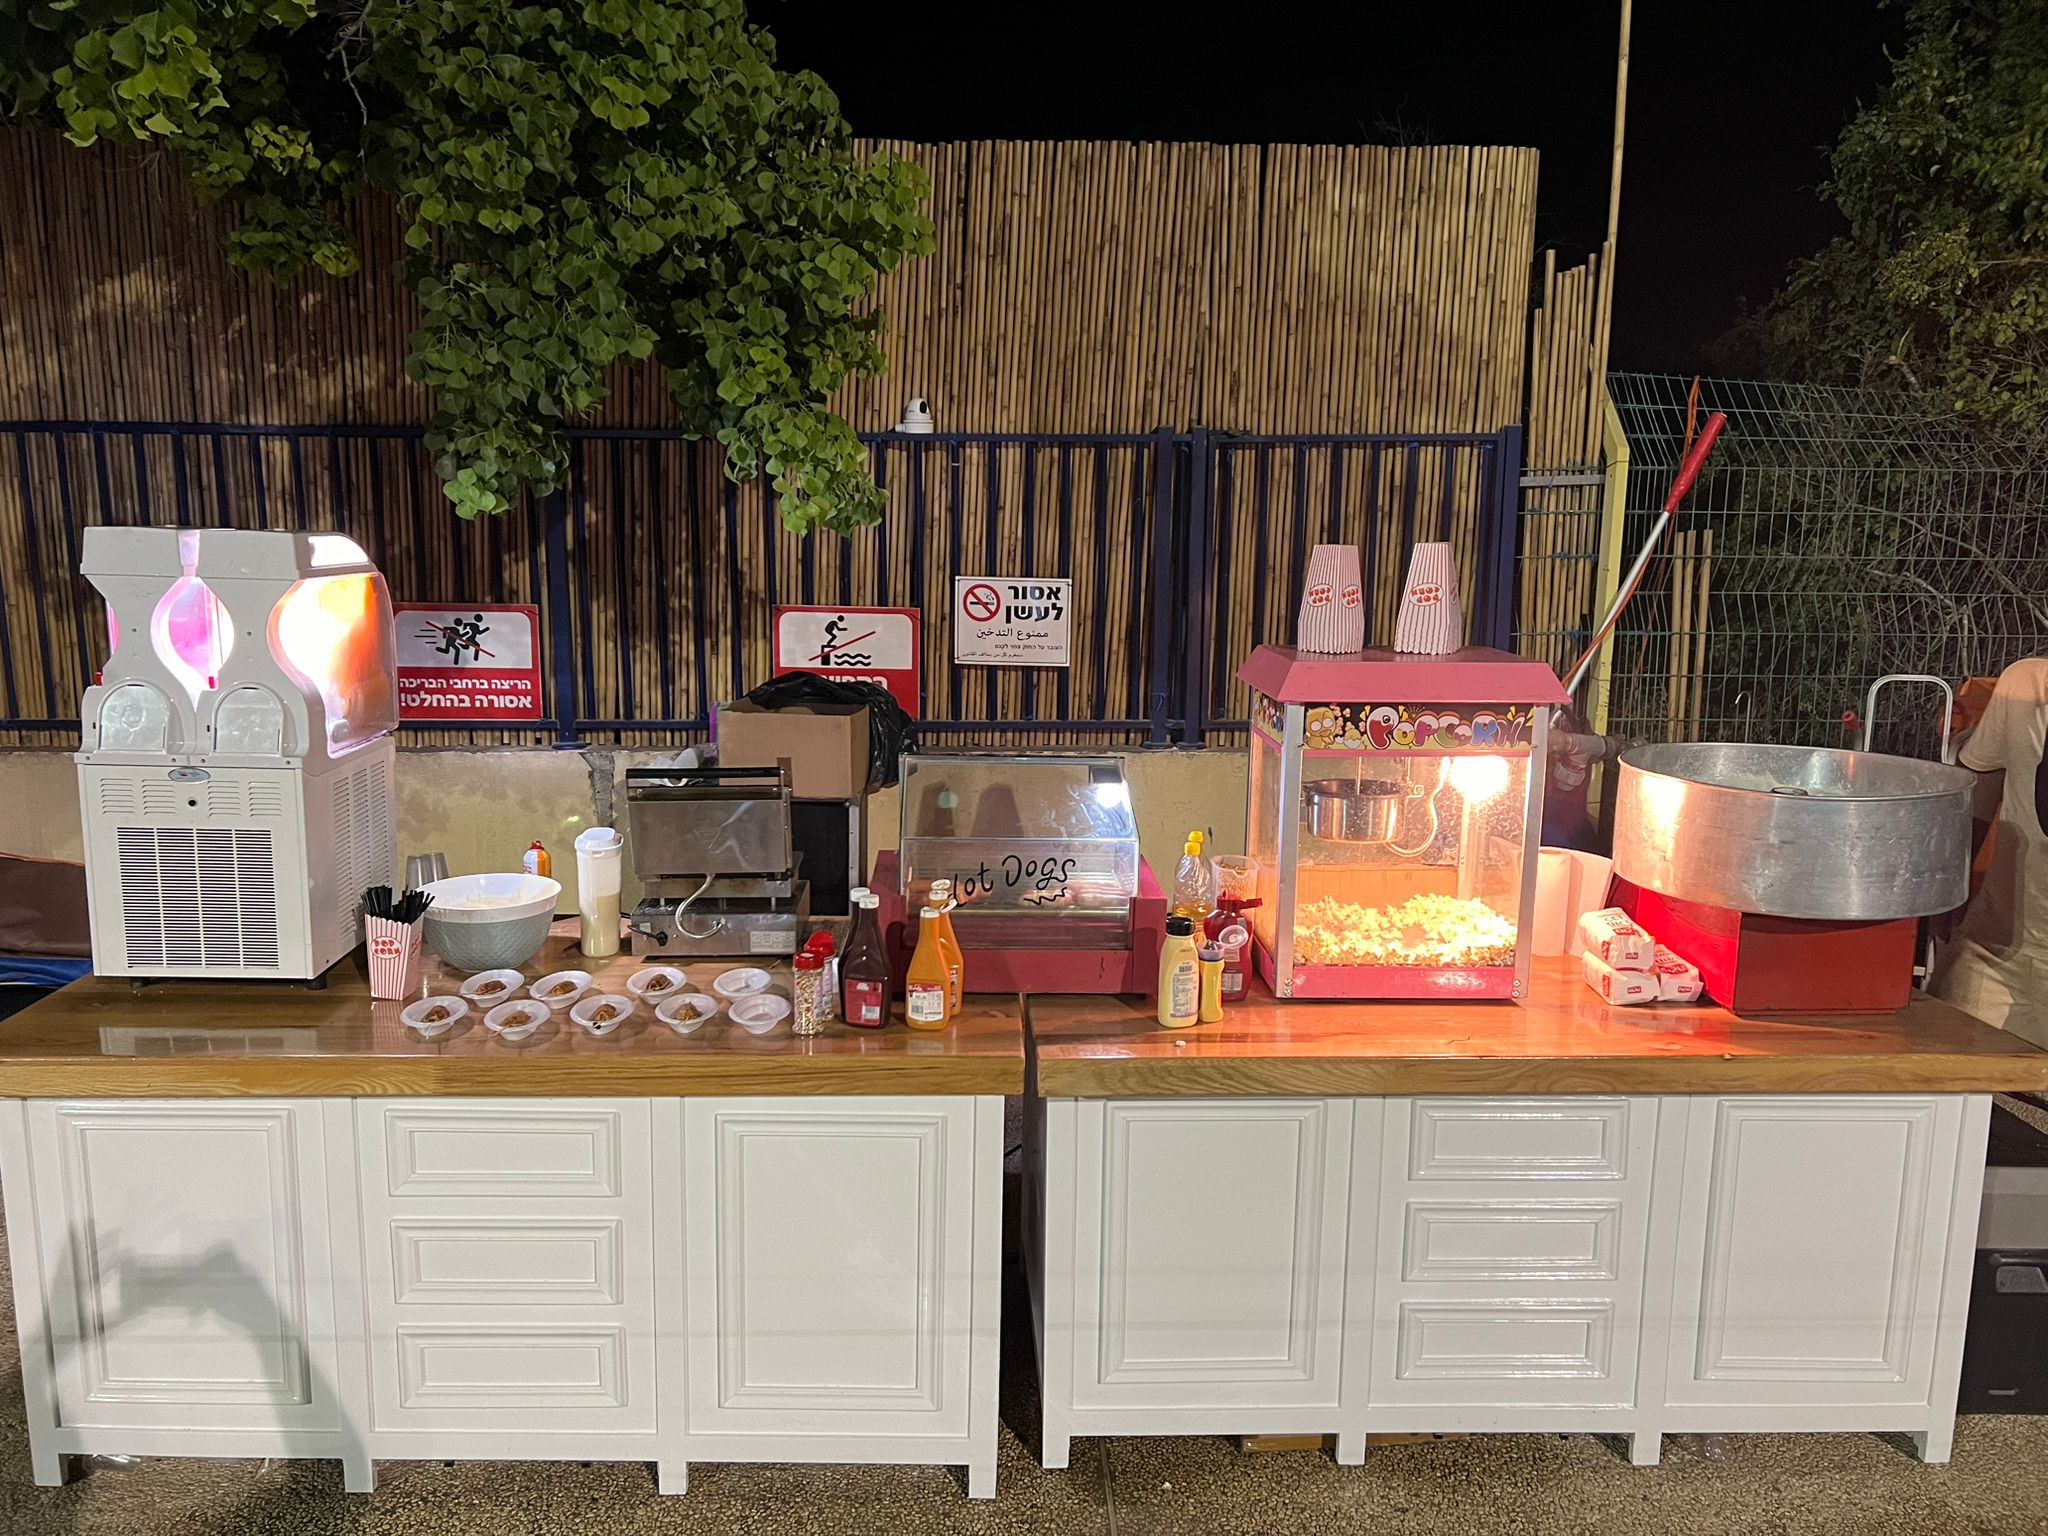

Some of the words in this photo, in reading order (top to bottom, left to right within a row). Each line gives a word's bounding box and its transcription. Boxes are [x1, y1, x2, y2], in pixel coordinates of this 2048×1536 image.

[1007, 585, 1062, 601] אסור
[1005, 602, 1064, 624] לעשן
[976, 628, 1013, 640] التدخين
[1016, 629, 1049, 641] ممنوع
[399, 678, 447, 689] הבריכה
[449, 678, 489, 689] ברחבי
[491, 678, 532, 690] הריצה
[400, 691, 471, 708] בהחלט!
[474, 694, 533, 709] אסורה
